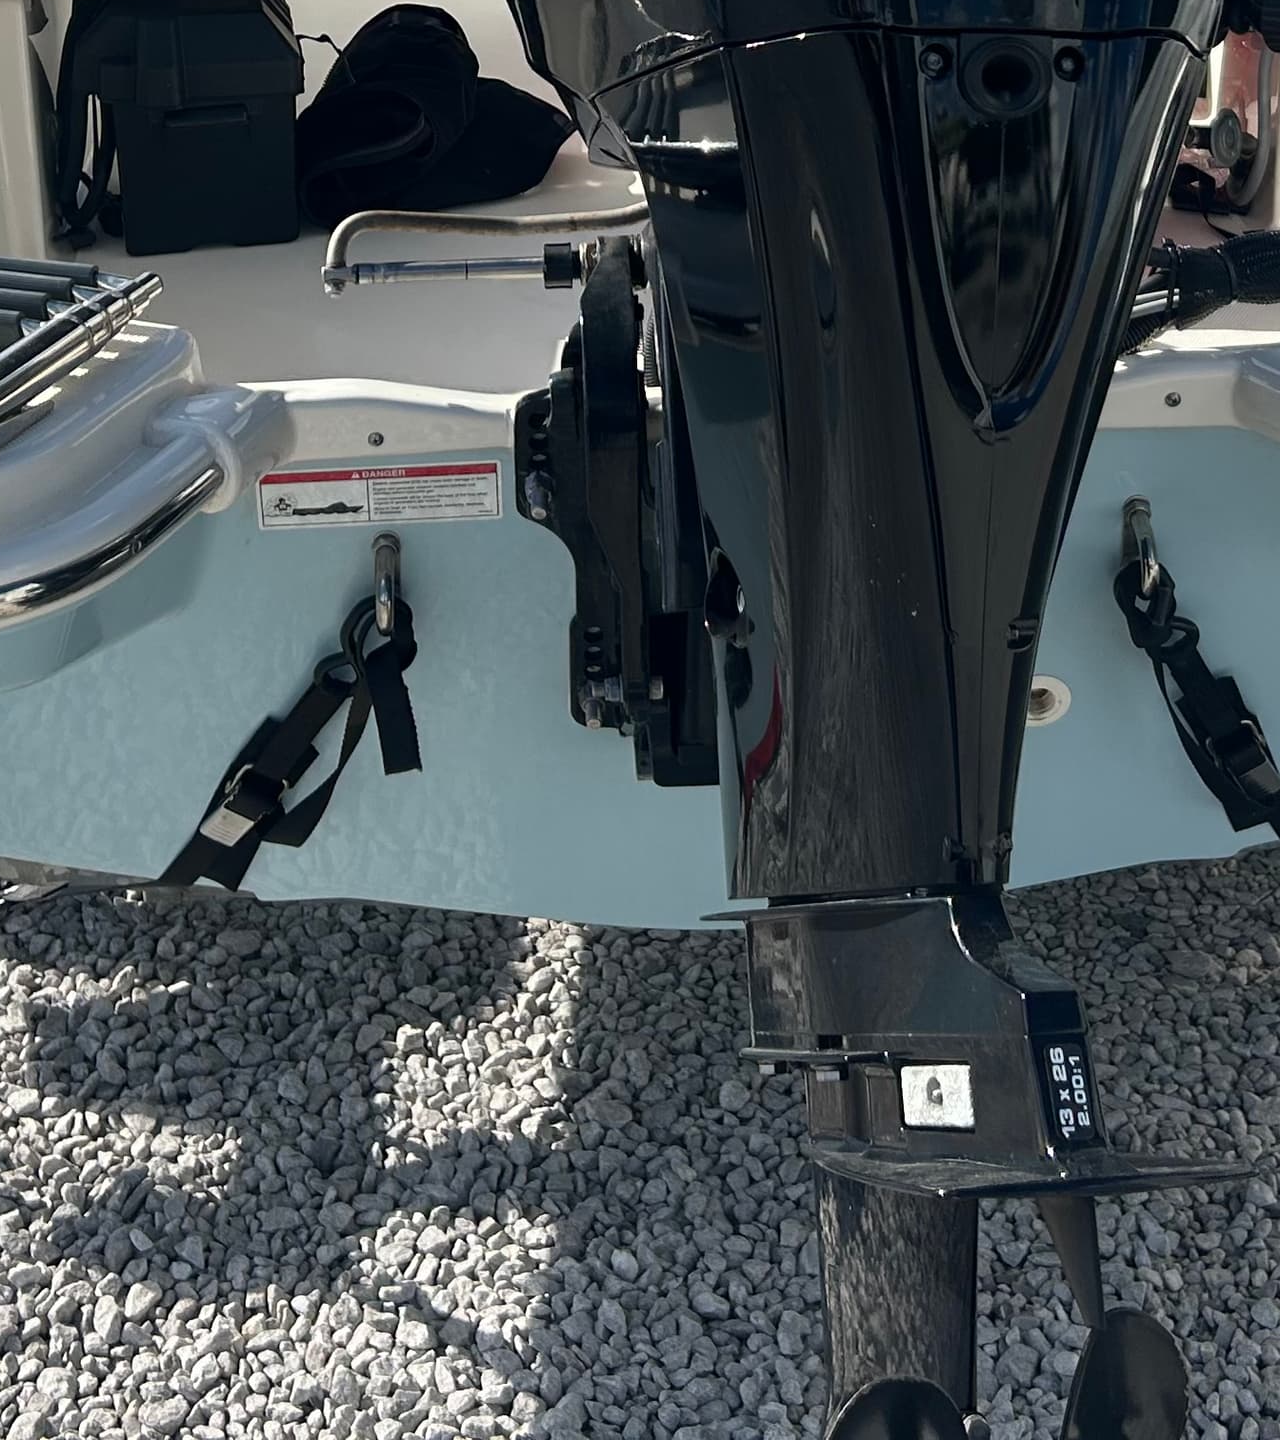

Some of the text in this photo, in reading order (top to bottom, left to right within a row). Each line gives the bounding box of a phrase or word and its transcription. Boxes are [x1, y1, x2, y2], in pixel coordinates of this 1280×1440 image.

[361, 469, 406, 479] DANGER
[1049, 1047, 1068, 1082] 26
[1068, 1055, 1091, 1127] 2.00:1
[1058, 1107, 1076, 1139] 13
